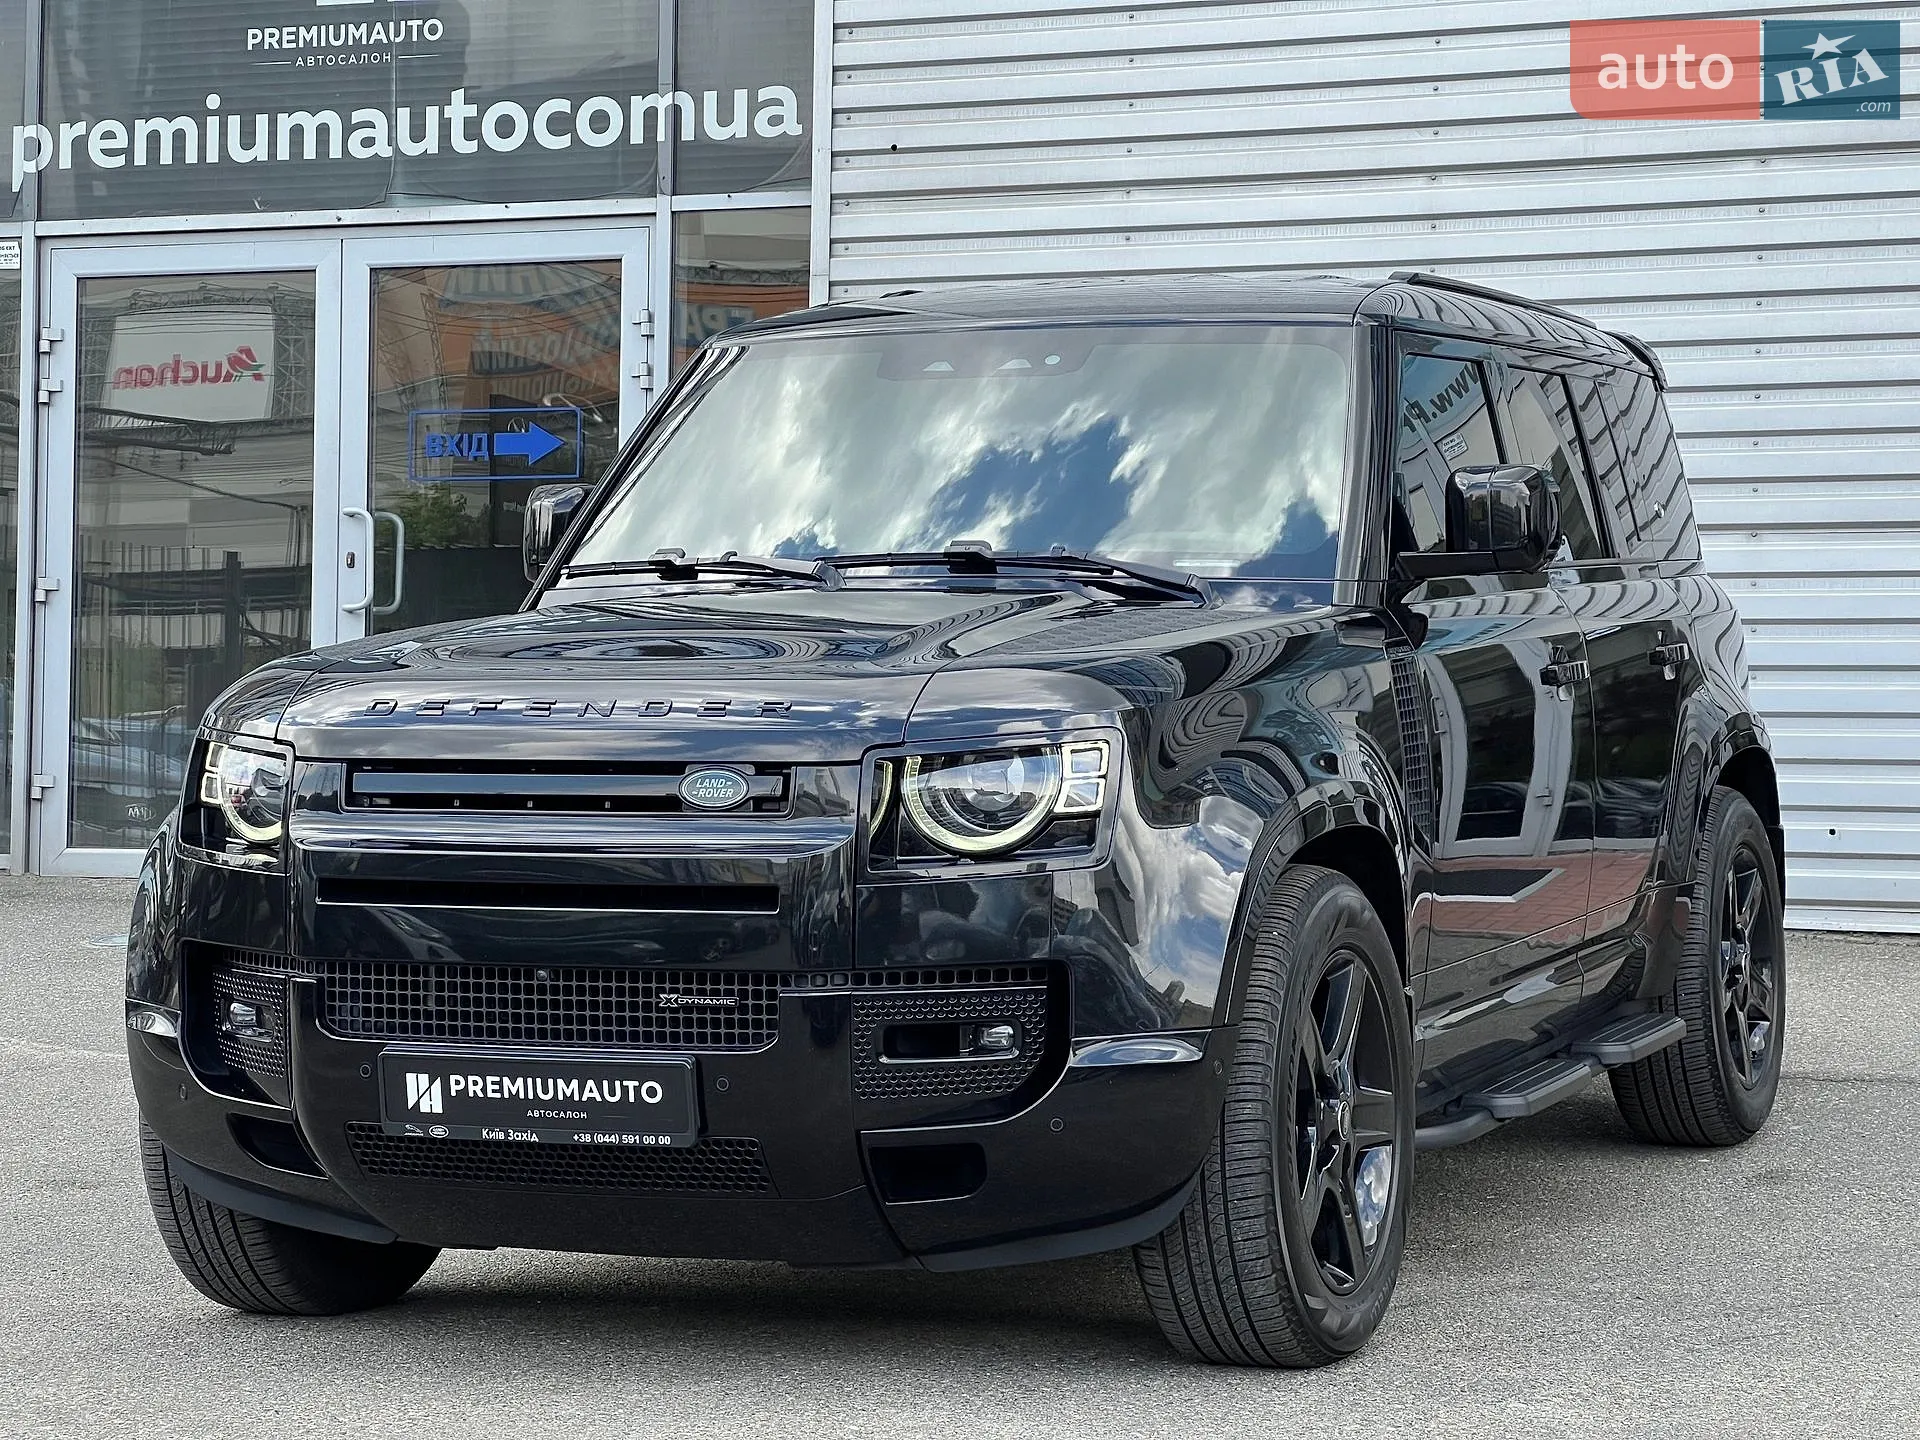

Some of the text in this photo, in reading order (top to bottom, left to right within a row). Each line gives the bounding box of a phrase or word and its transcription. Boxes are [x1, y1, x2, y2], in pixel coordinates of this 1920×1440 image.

[247, 18, 444, 50] PREMIUMAUTO
[295, 51, 392, 67] АВТОСАЛОН
[12, 84, 803, 193] premiumautocomua
[425, 432, 489, 461] ВХІД
[363, 698, 794, 718] DEFENDER
[449, 1074, 664, 1105] PREMIUMAUTO
[526, 1109, 588, 1119] АВТОСАЛОН
[482, 1128, 539, 1143] Київ Захід
[573, 1133, 671, 1145] +38 (044) 591 00 00
